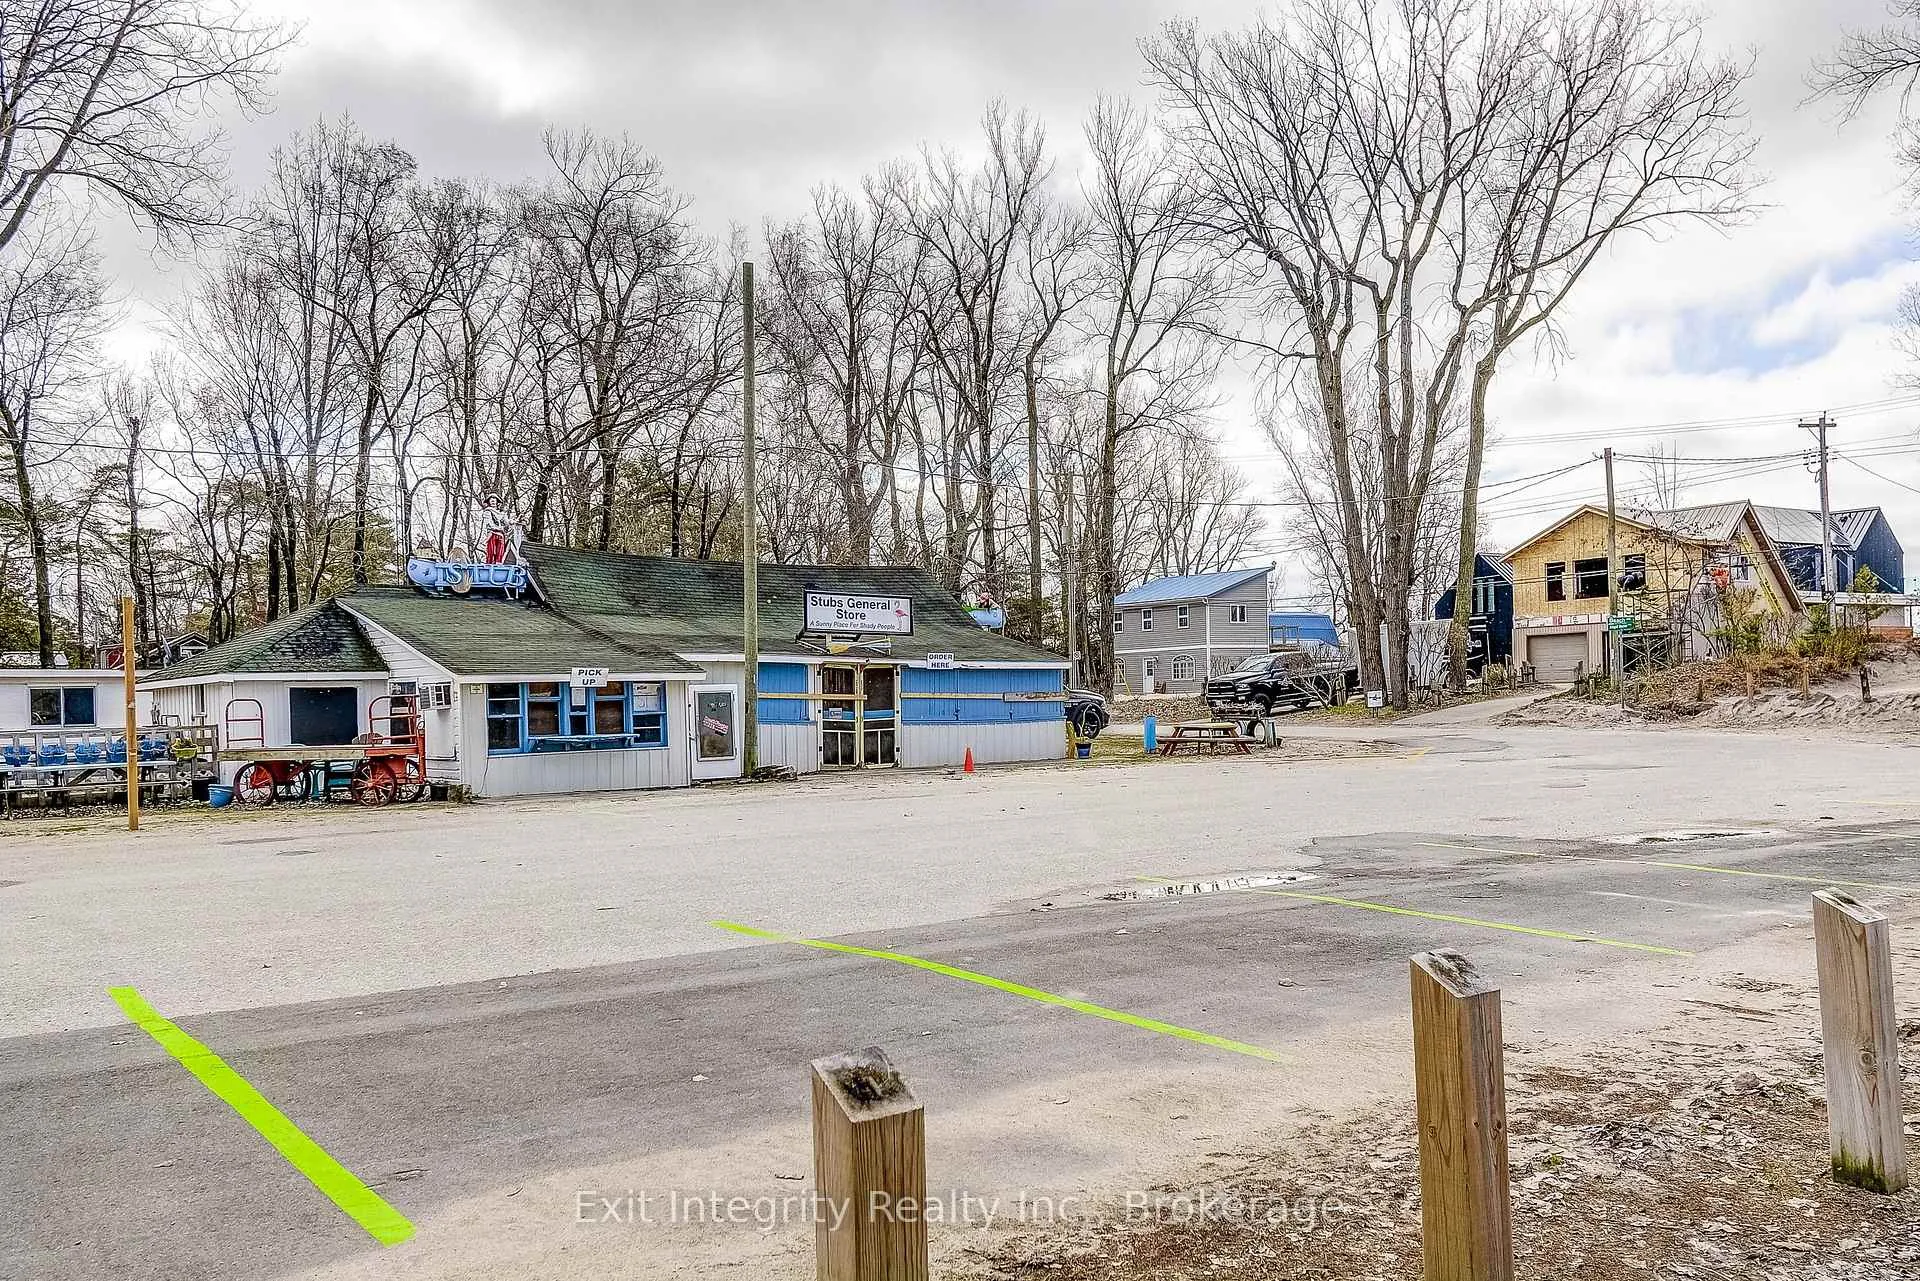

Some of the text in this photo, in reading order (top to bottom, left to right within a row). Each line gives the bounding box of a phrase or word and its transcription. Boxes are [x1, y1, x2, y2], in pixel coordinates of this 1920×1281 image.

[810, 596, 891, 610] Stubs General
[836, 609, 866, 620] Store
